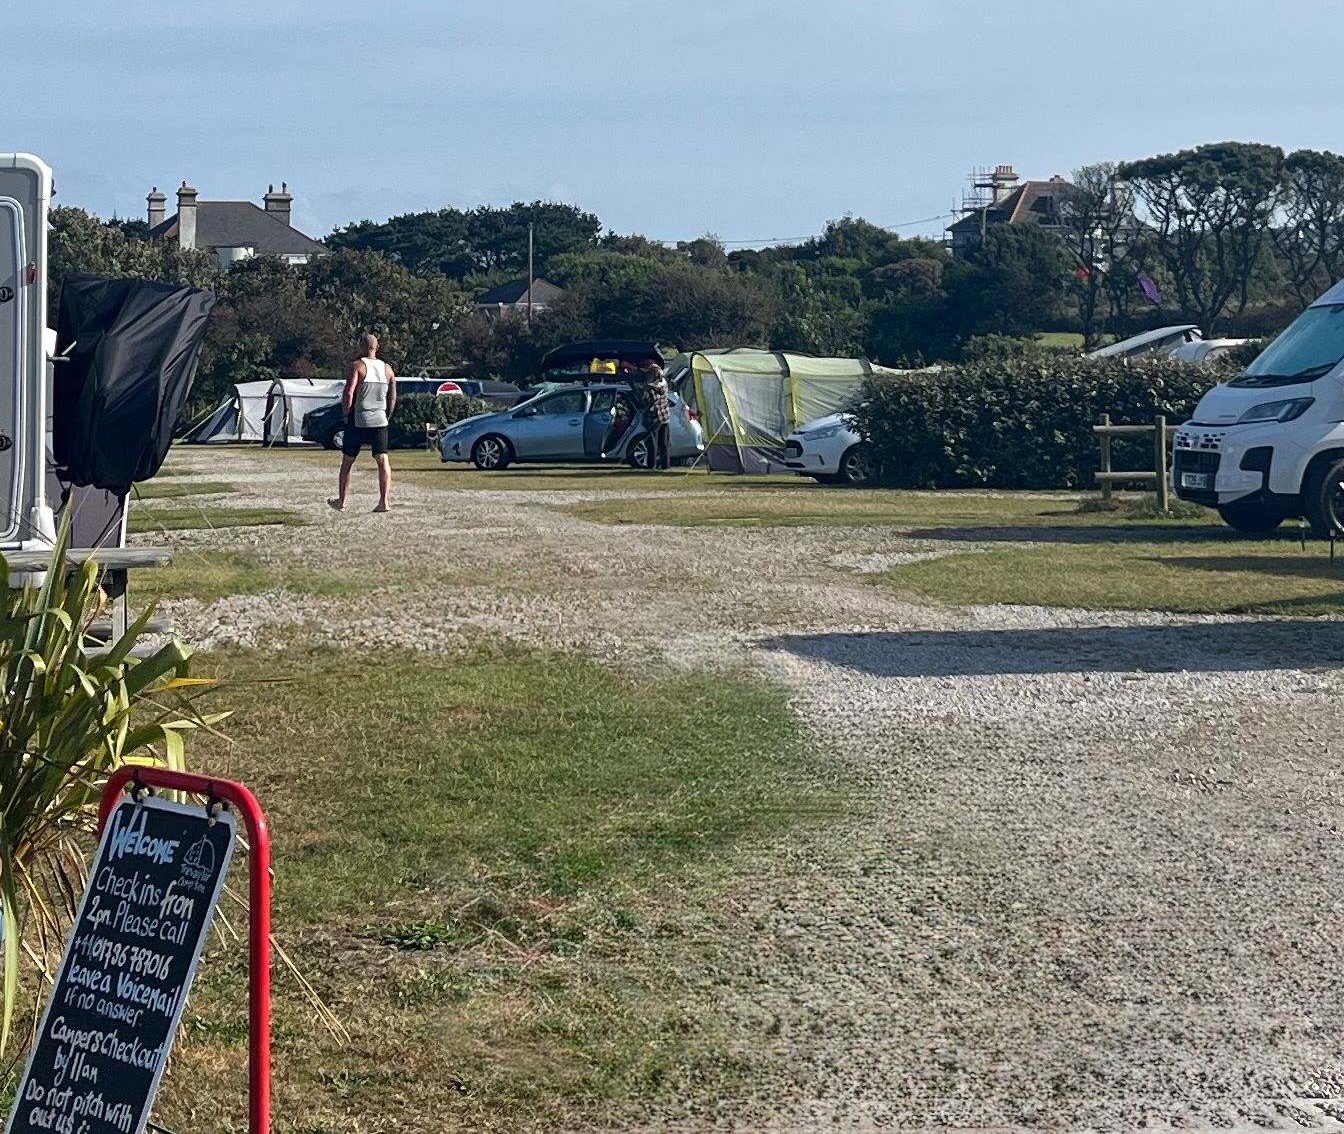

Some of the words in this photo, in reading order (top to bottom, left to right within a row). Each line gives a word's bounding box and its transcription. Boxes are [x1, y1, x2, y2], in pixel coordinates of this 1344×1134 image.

[112, 900, 159, 937] Please
[76, 992, 95, 1011] no
[25, 1077, 45, 1101] Do
[45, 1086, 74, 1113] not
[71, 1090, 104, 1124] pitch
[29, 1106, 57, 1129] out
